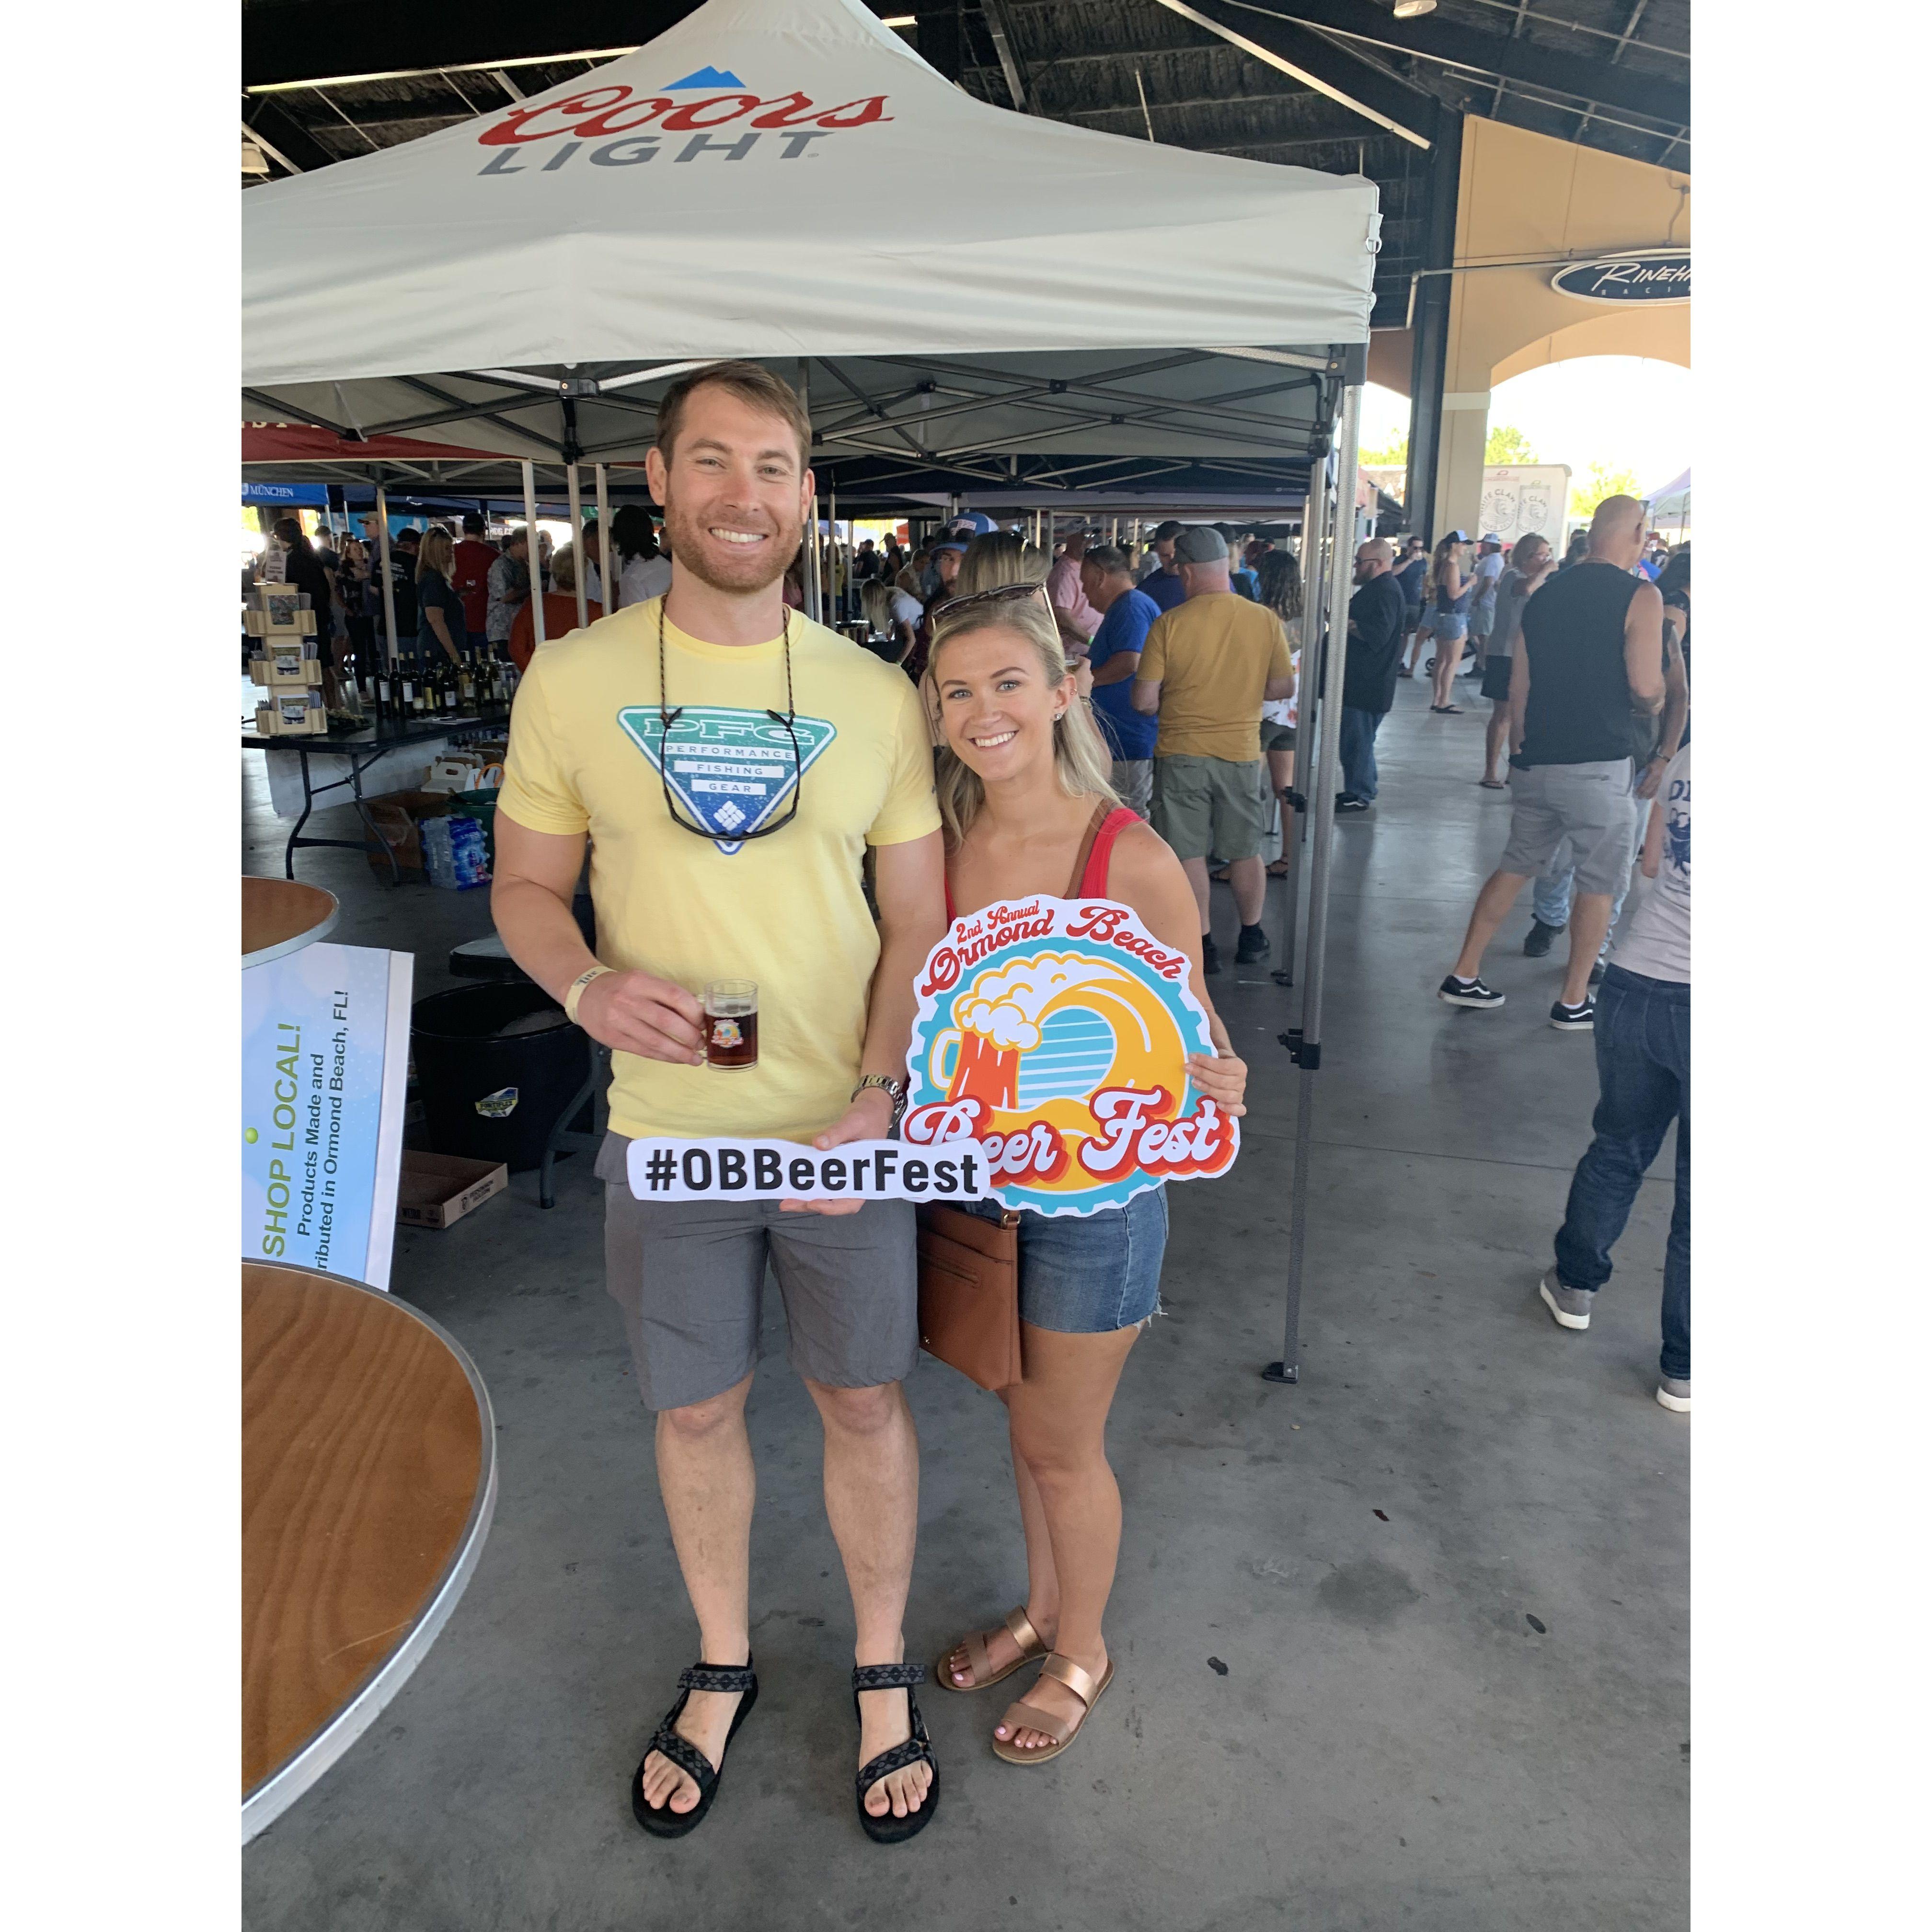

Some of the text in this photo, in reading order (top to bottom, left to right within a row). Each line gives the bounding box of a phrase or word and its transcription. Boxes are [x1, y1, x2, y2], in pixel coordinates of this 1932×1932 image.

[478, 85, 894, 146] Coors
[477, 131, 835, 176] LIGHT
[250, 484, 294, 497] MÜNCHEN
[644, 718, 815, 746] PFG
[666, 745, 794, 759] PERFORMANCE
[697, 764, 764, 775] FISHING
[709, 783, 752, 793] GEAR
[956, 900, 1040, 944] 2nd Annual
[921, 906, 1186, 997] Ormond Beach
[334, 990, 349, 1021] FL!
[329, 1027, 348, 1091] Beach,
[263, 1023, 302, 1257] SHOP LOCAL!
[297, 1053, 324, 1236] Products Made and
[324, 1096, 342, 1174] Ormond
[906, 1087, 1223, 1179] Beer Fest
[322, 1180, 335, 1197] in
[646, 1149, 978, 1194] #OBBeerFest
